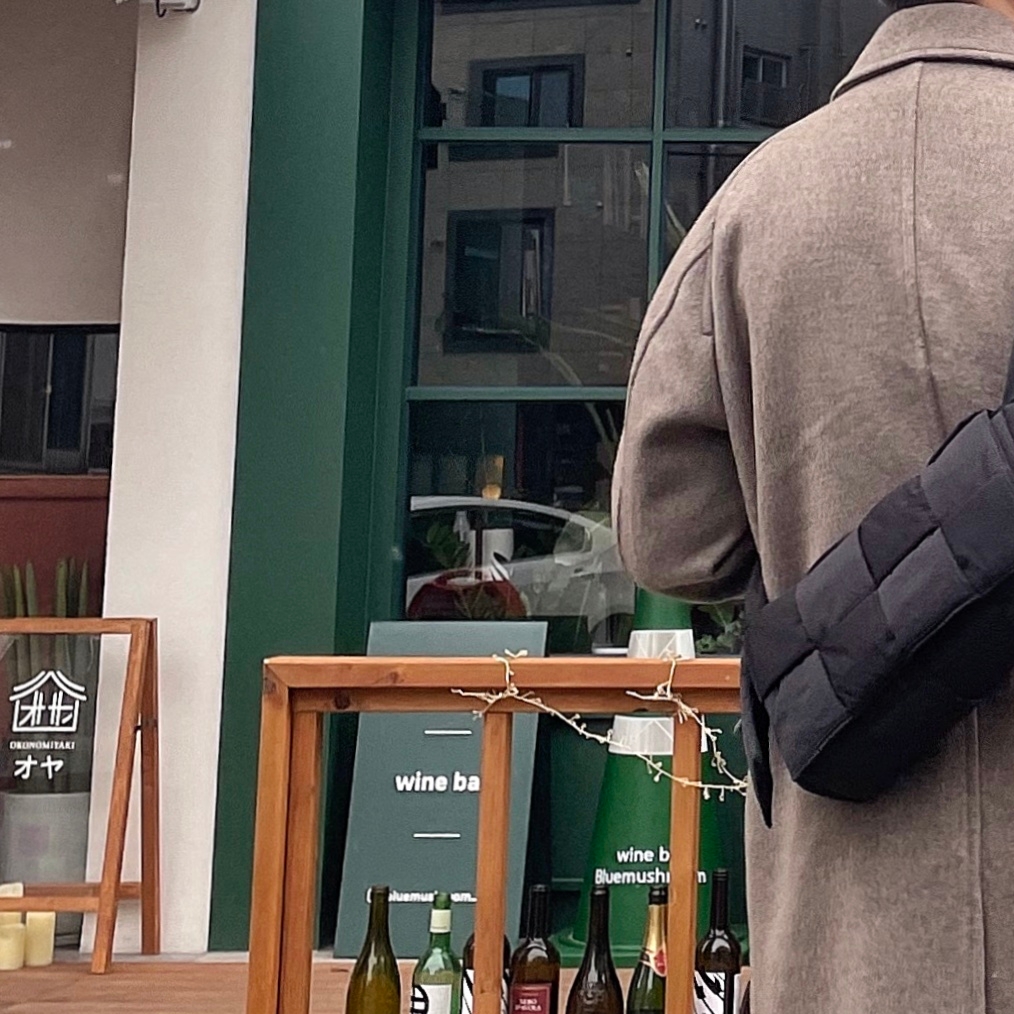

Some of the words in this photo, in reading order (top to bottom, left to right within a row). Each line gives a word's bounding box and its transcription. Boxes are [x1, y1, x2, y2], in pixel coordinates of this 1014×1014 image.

[9, 741, 76, 751] OKONOMIYAKI
[14, 754, 64, 779] オヤ
[395, 770, 448, 792] wine
[452, 770, 480, 792] ba
[616, 847, 655, 863] wine
[594, 866, 707, 885] Bluemushrm
